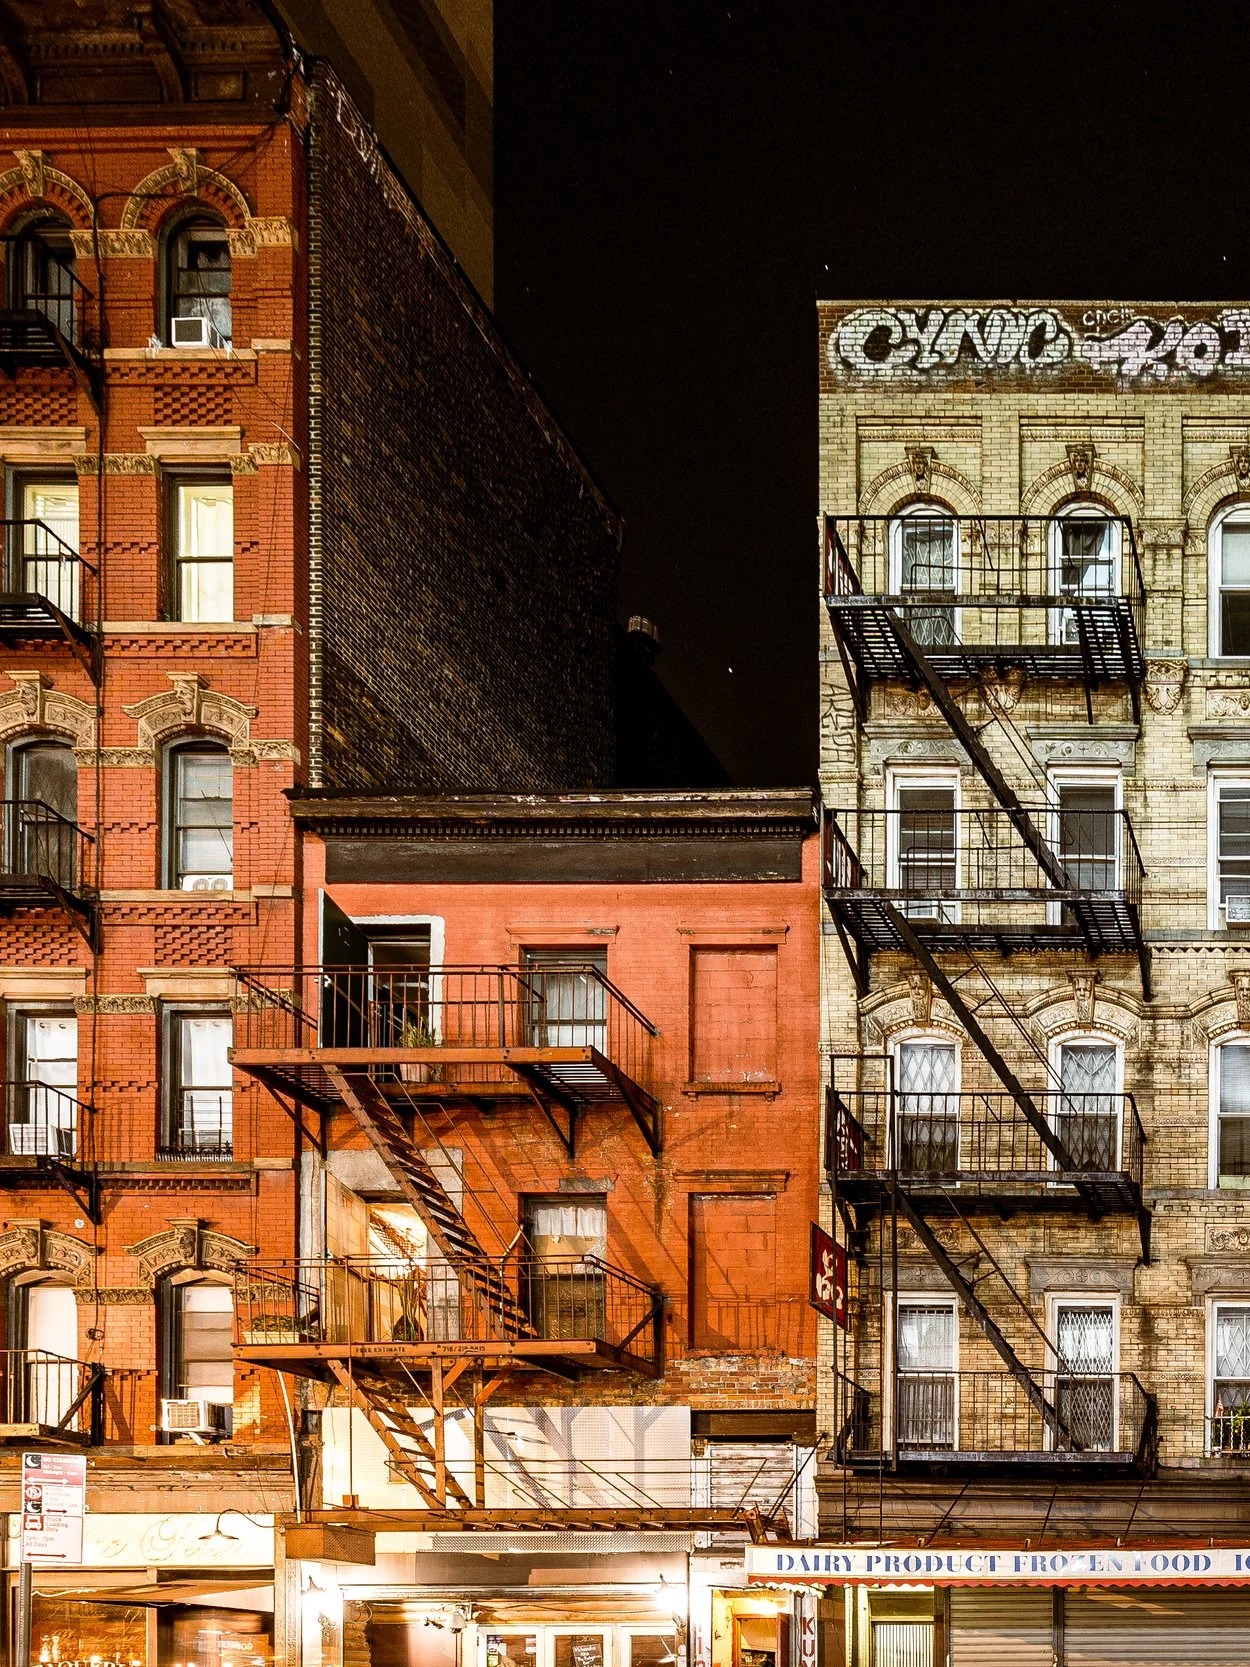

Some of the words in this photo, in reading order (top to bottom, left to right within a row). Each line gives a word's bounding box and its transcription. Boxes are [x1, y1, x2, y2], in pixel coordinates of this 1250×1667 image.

[777, 1554, 852, 1571] DAIRY
[866, 1554, 1001, 1572] PRODUCT
[1133, 1554, 1212, 1571] FOOD
